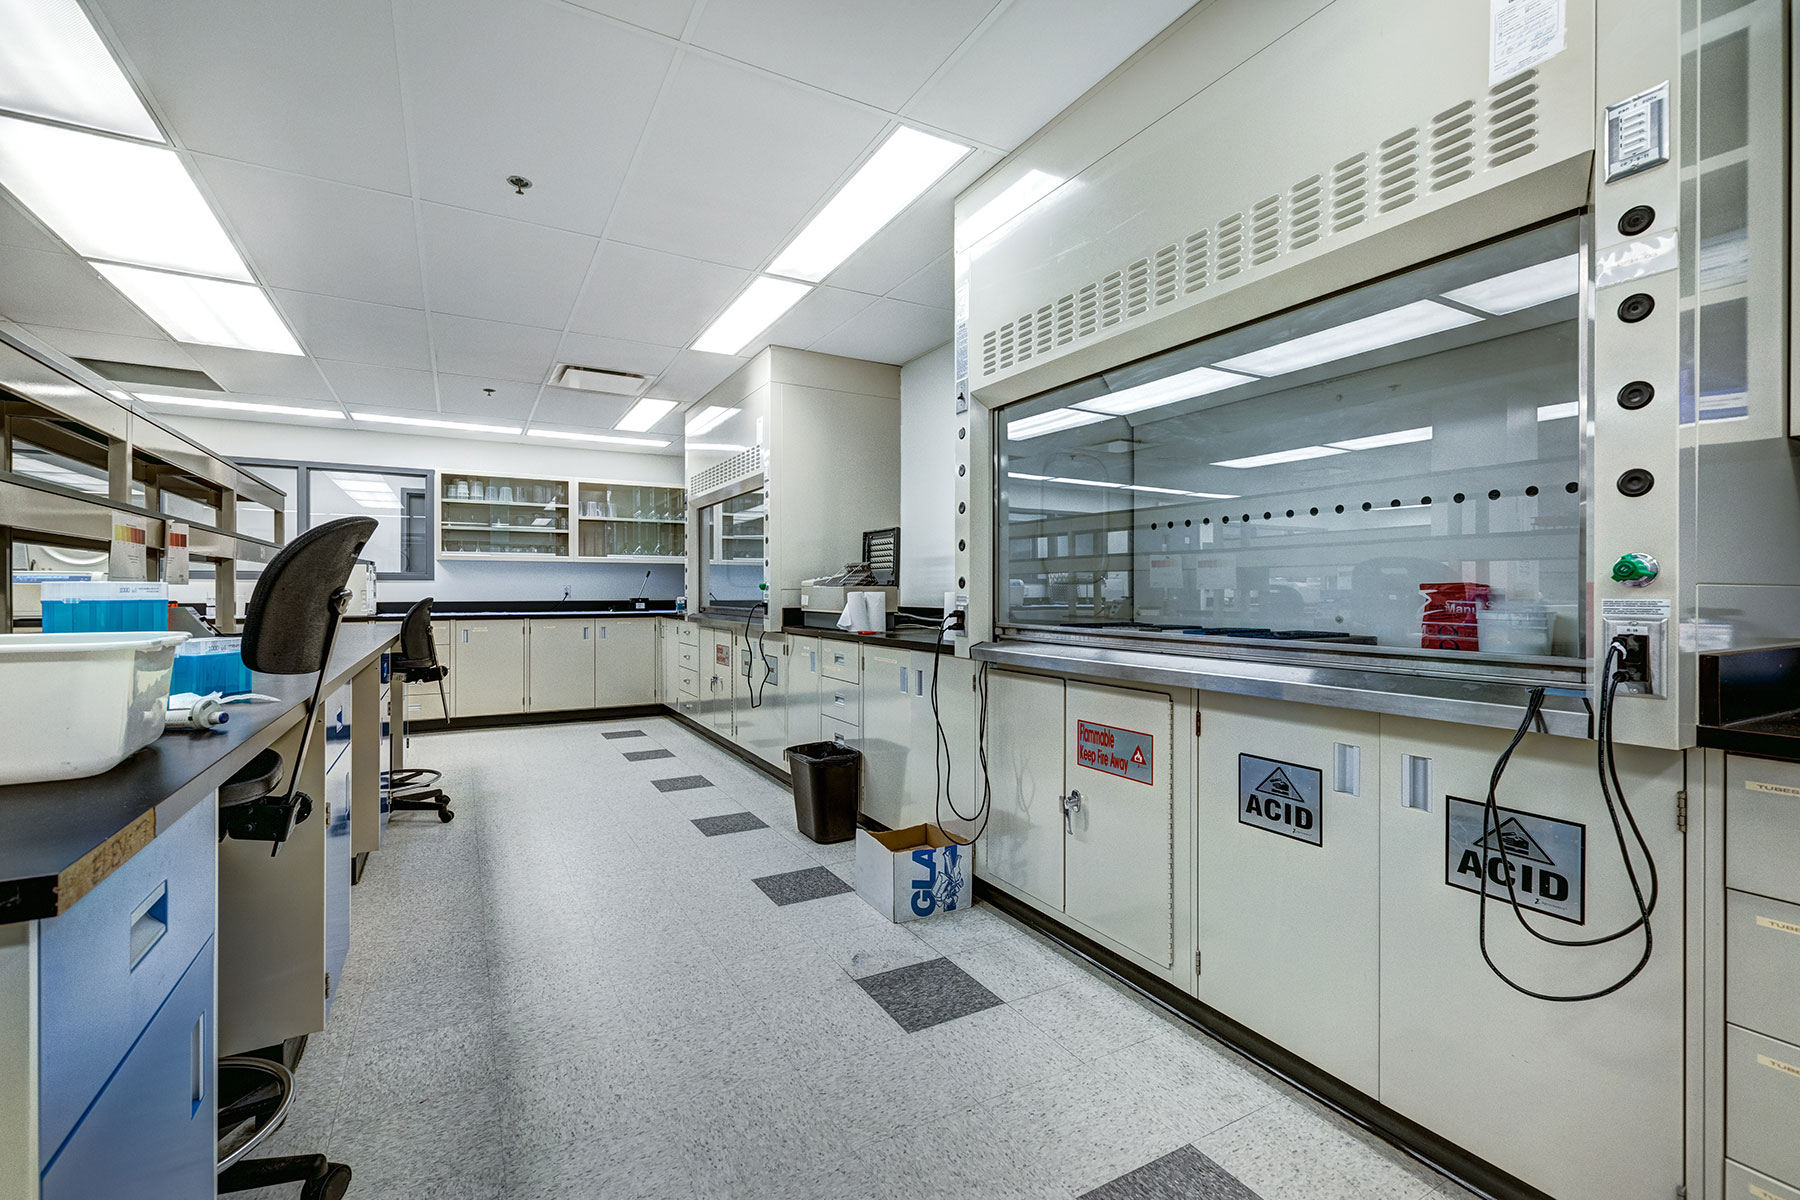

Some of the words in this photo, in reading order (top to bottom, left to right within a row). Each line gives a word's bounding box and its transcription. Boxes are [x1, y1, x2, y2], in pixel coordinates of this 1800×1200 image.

[1080, 723, 1115, 749] Flammable
[1080, 745, 1096, 766] Keep
[1097, 749, 1109, 767] Fire
[1110, 752, 1129, 775] Away
[1245, 793, 1313, 830] ACID
[910, 848, 937, 917] GLA
[1457, 849, 1569, 902] ACID
